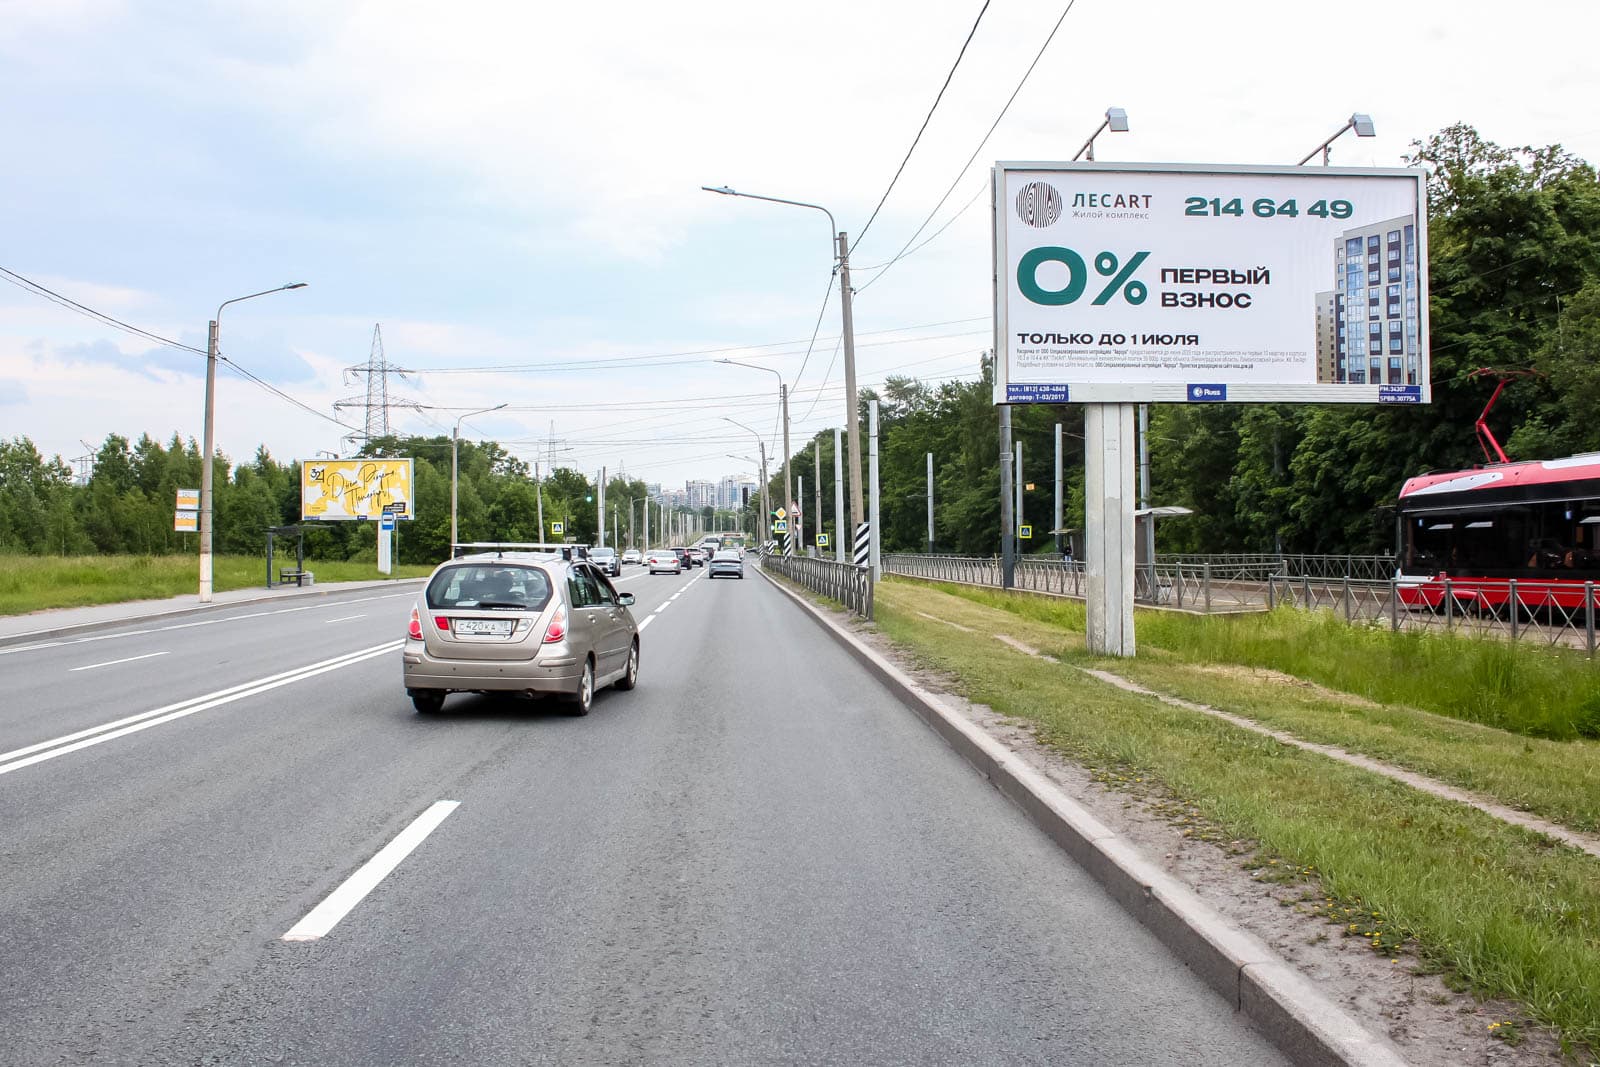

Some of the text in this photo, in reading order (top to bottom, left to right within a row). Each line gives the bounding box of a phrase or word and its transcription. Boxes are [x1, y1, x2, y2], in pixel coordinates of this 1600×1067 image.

[1072, 210, 1150, 220] Жилой комплекс
[1184, 197, 1353, 219] 214 64 49
[1017, 246, 1152, 306] 0%
[1161, 266, 1270, 285] ПЕРВЫЙ
[1161, 292, 1252, 309] ВЗНОС
[1017, 333, 1199, 346] ТОЛЬКО ДО 1 ИЮЛЯ
[1203, 388, 1222, 396] Russ
